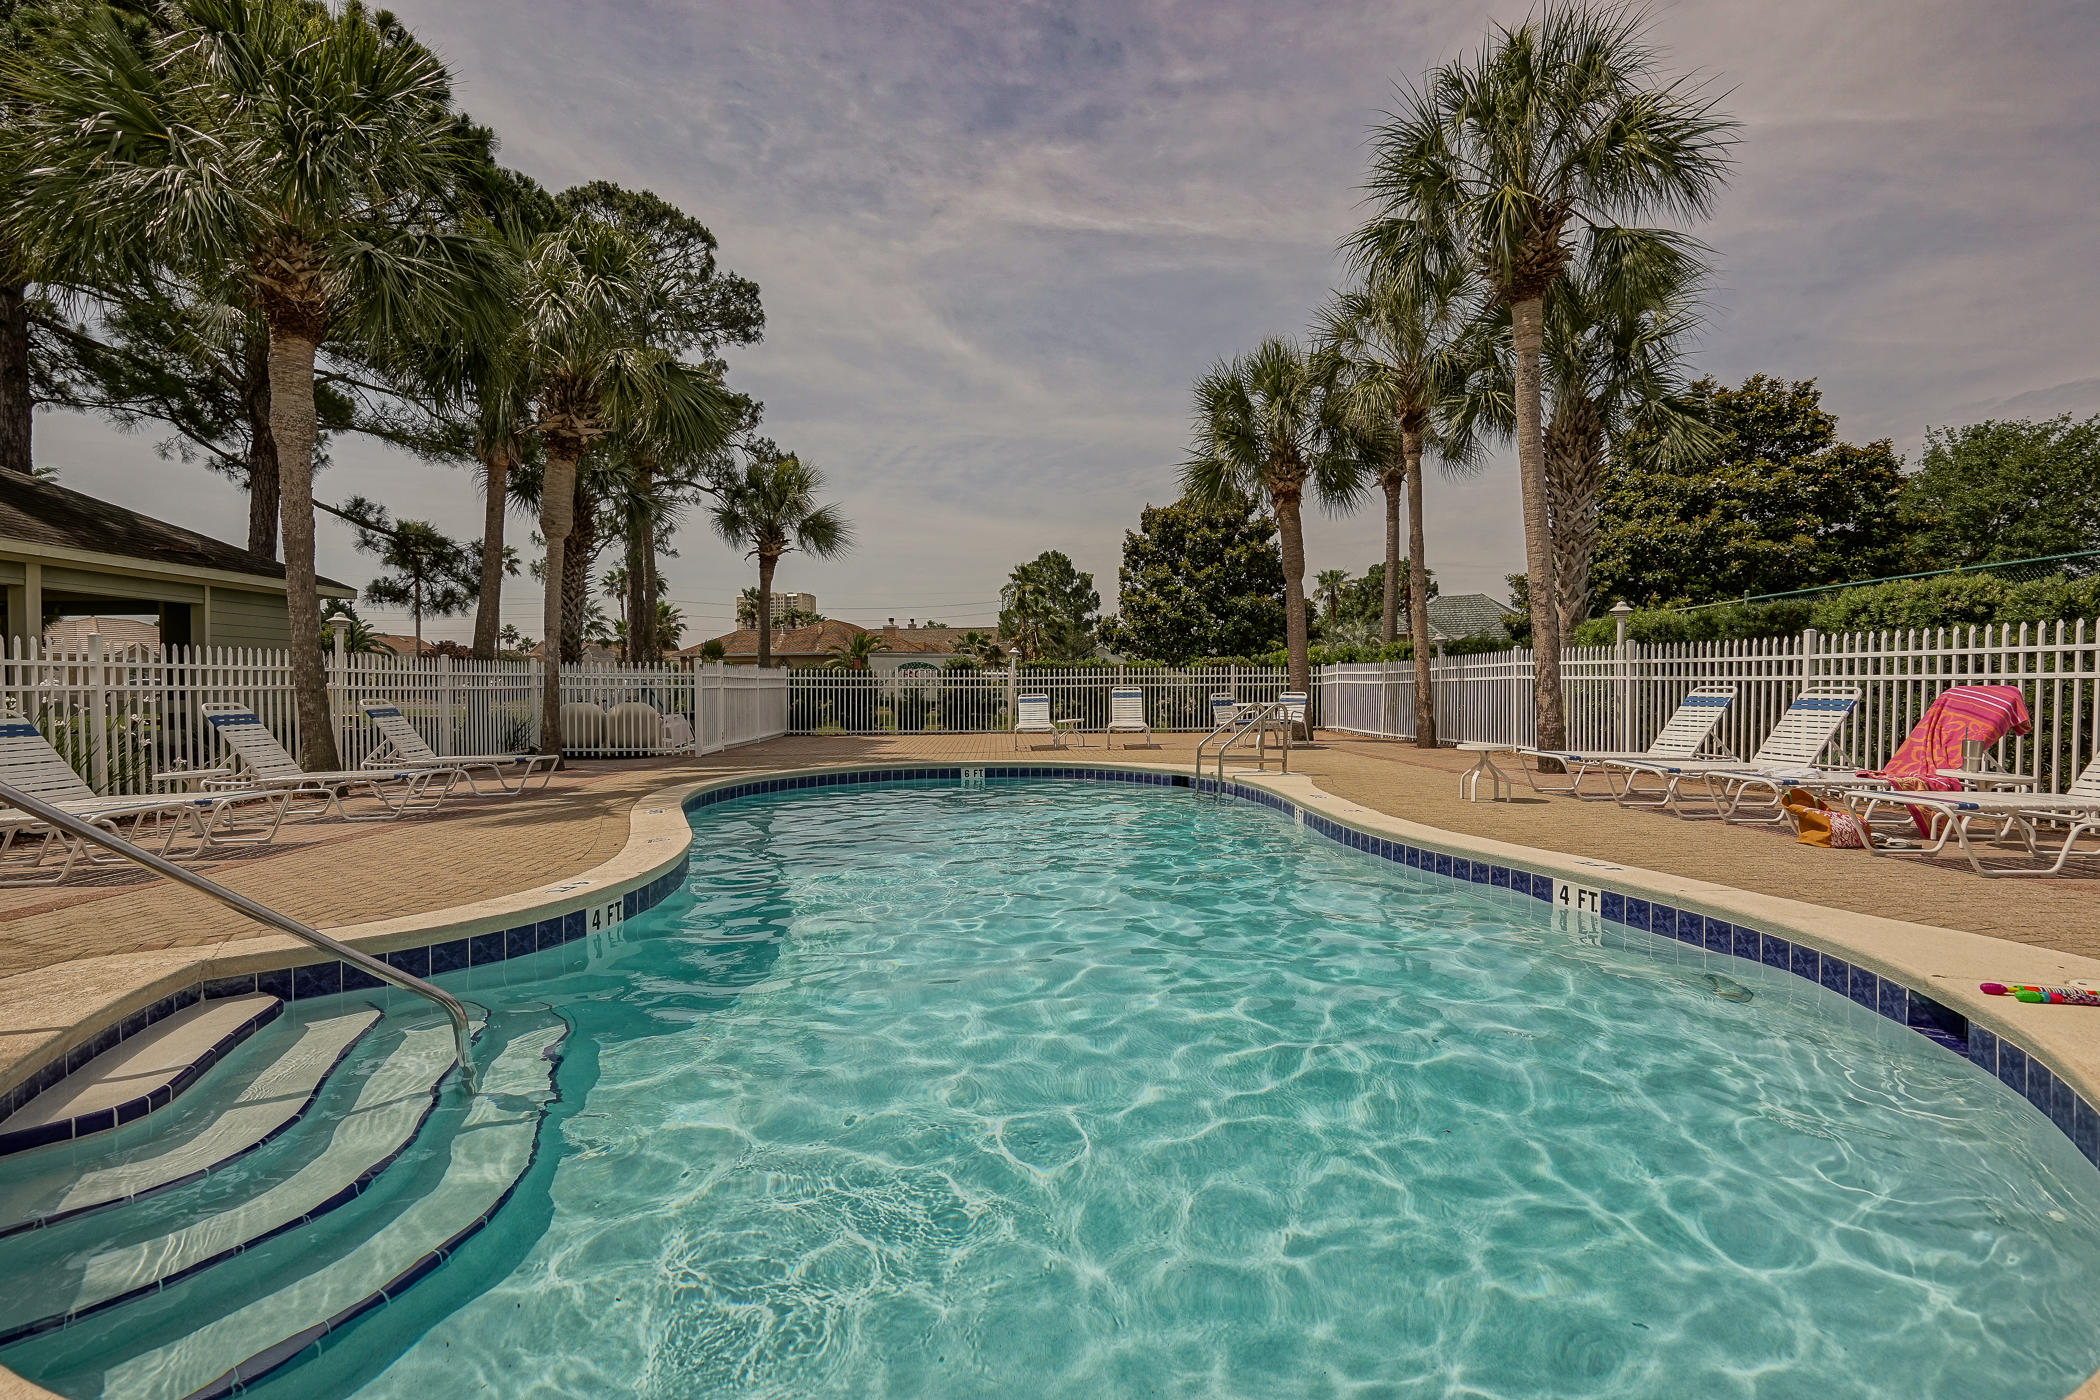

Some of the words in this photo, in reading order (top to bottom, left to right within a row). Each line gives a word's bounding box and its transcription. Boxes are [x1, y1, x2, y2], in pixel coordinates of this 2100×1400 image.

[964, 769, 970, 778] 6
[1560, 885, 1569, 905] 4
[1578, 888, 1598, 912] FT.
[592, 909, 601, 930] 4
[607, 901, 622, 926] FT.
